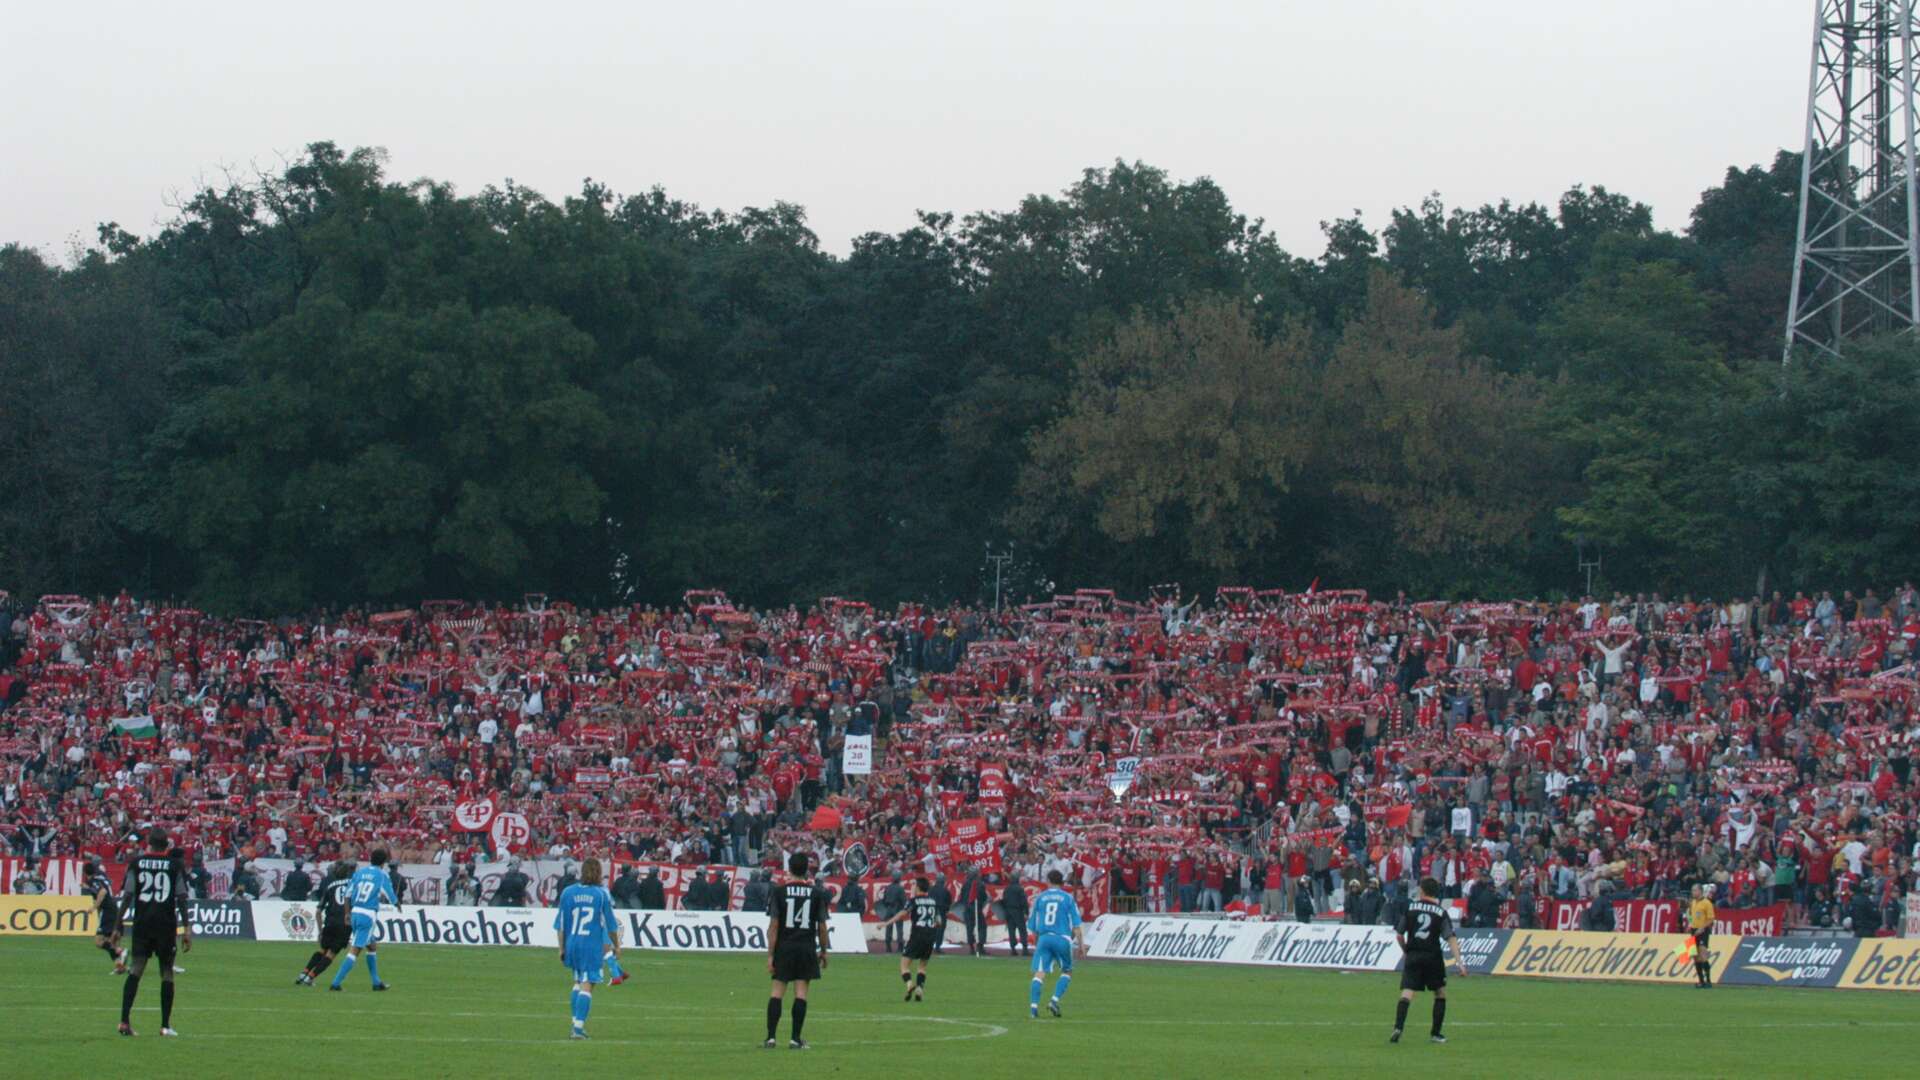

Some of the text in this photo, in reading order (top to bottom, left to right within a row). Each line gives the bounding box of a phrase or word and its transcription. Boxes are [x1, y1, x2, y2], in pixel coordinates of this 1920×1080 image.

[1118, 760, 1136, 773] 30
[138, 859, 170, 870] GUEYE
[138, 871, 171, 903] 29
[355, 880, 375, 902] 19
[786, 886, 812, 897] ILIEV
[571, 907, 594, 936] 12
[785, 898, 811, 928] 14
[916, 905, 936, 928] 23
[1044, 902, 1058, 926] 8
[373, 908, 533, 944] ombacher
[1414, 914, 1431, 940] 2
[1121, 921, 1236, 960] Krombacher
[1268, 925, 1392, 967] Krombacher
[1749, 941, 1842, 966] betandwin
